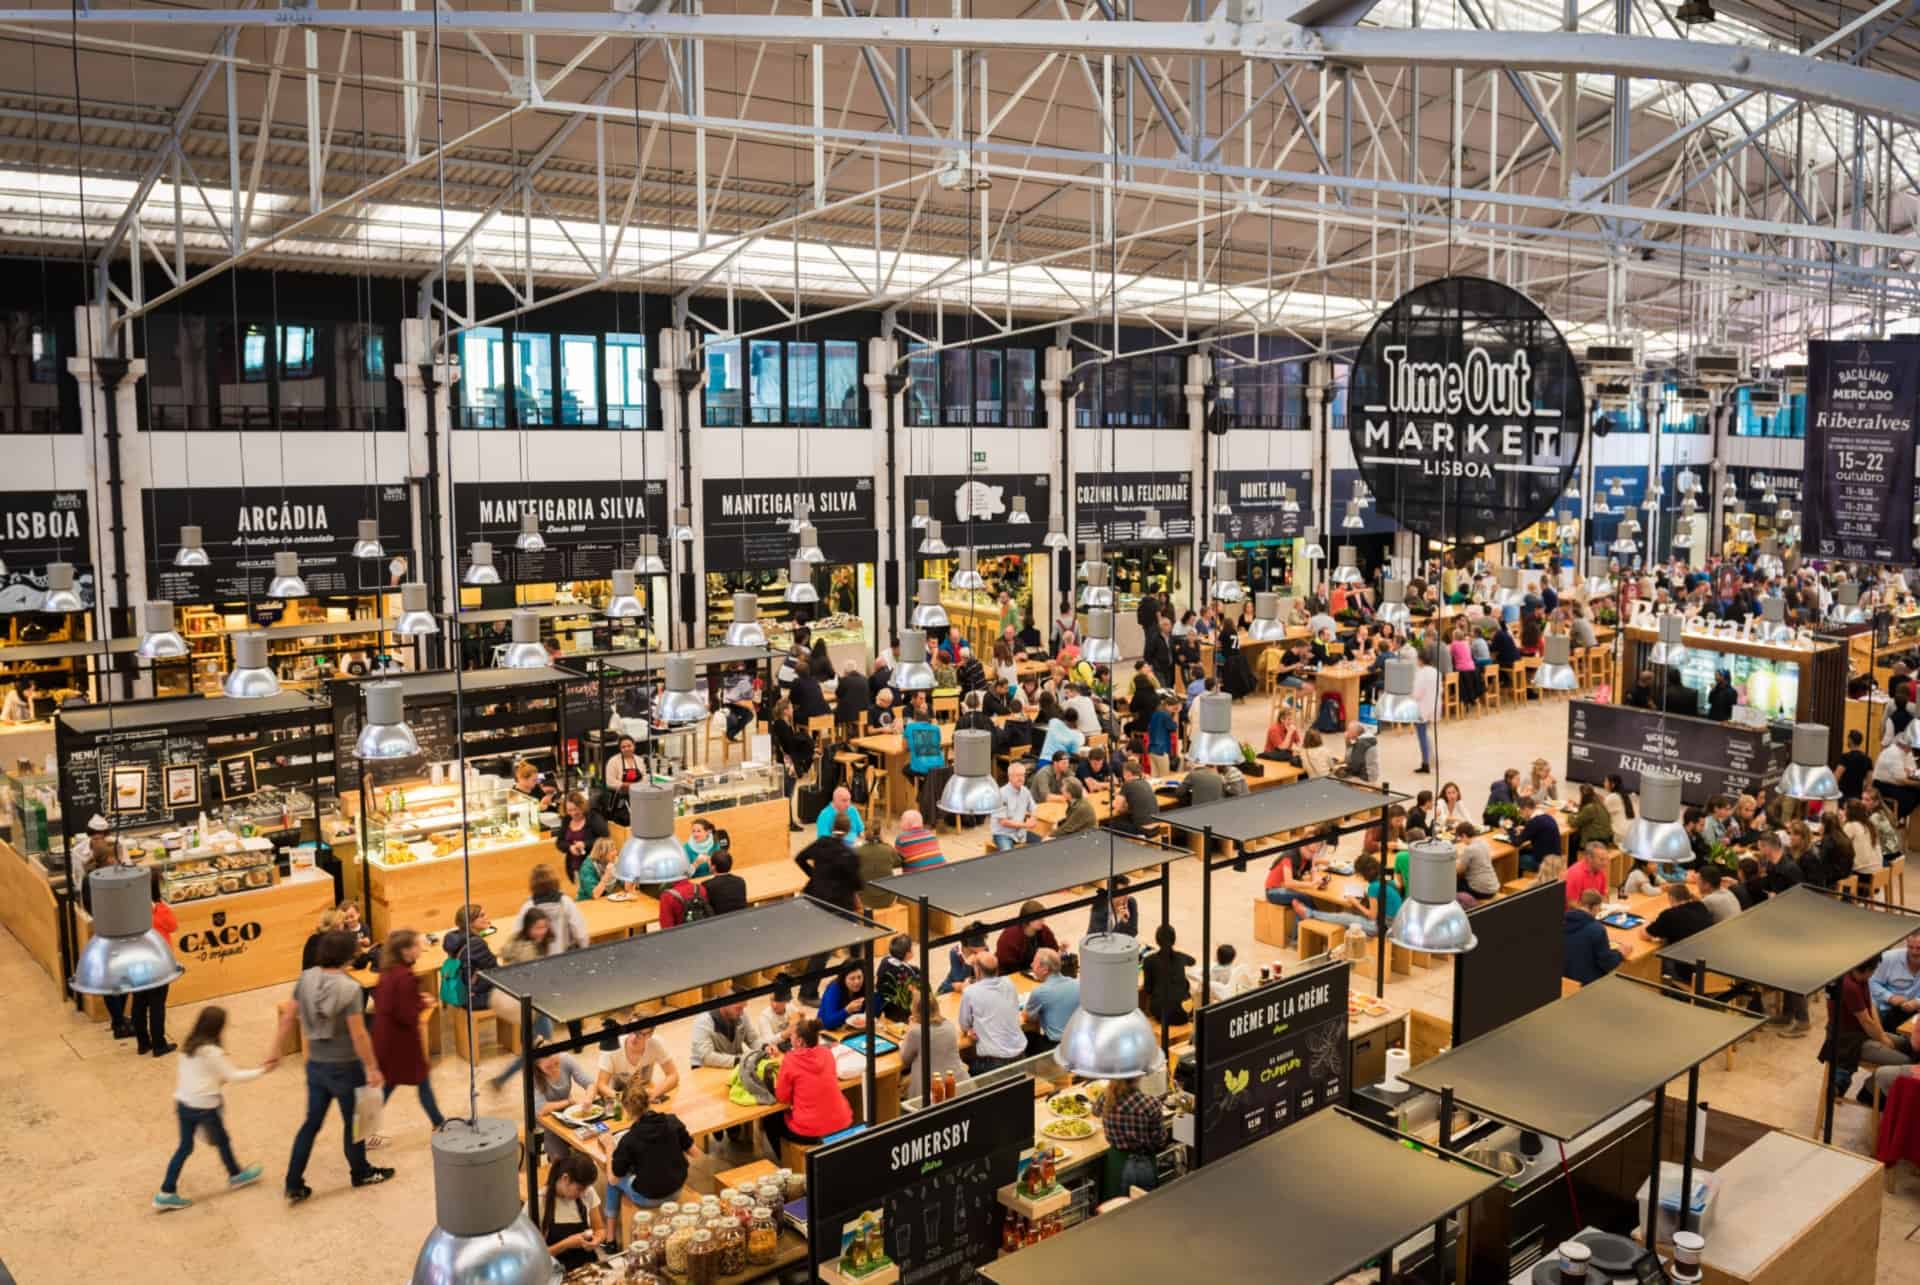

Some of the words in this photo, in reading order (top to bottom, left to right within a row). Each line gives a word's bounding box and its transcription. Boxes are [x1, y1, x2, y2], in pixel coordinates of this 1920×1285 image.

[1384, 345, 1463, 414] Time
[1464, 347, 1531, 417] Out
[1838, 367, 1889, 385] BACALHAU
[1832, 389, 1894, 401] MERCADO
[1816, 411, 1911, 431] Riberalves
[1363, 419, 1560, 457] MARKET
[1423, 459, 1493, 478] LISBOA
[1835, 471, 1885, 482] outubro
[1121, 485, 1135, 502] DA
[1137, 484, 1189, 502] FELICIDADE
[1240, 482, 1268, 498] MONTE
[479, 498, 594, 524] MANTEIGARIA
[600, 496, 646, 519] SILVA
[819, 491, 857, 513] SILVA
[238, 501, 328, 532] ARCÁDIA
[179, 922, 261, 952] CACO
[1229, 1008, 1264, 1038] CRÈME
[1267, 1002, 1281, 1024] DE
[1283, 997, 1294, 1018] LA
[1297, 984, 1330, 1013] CRÈME
[891, 1119, 971, 1171] SOMERSBY
